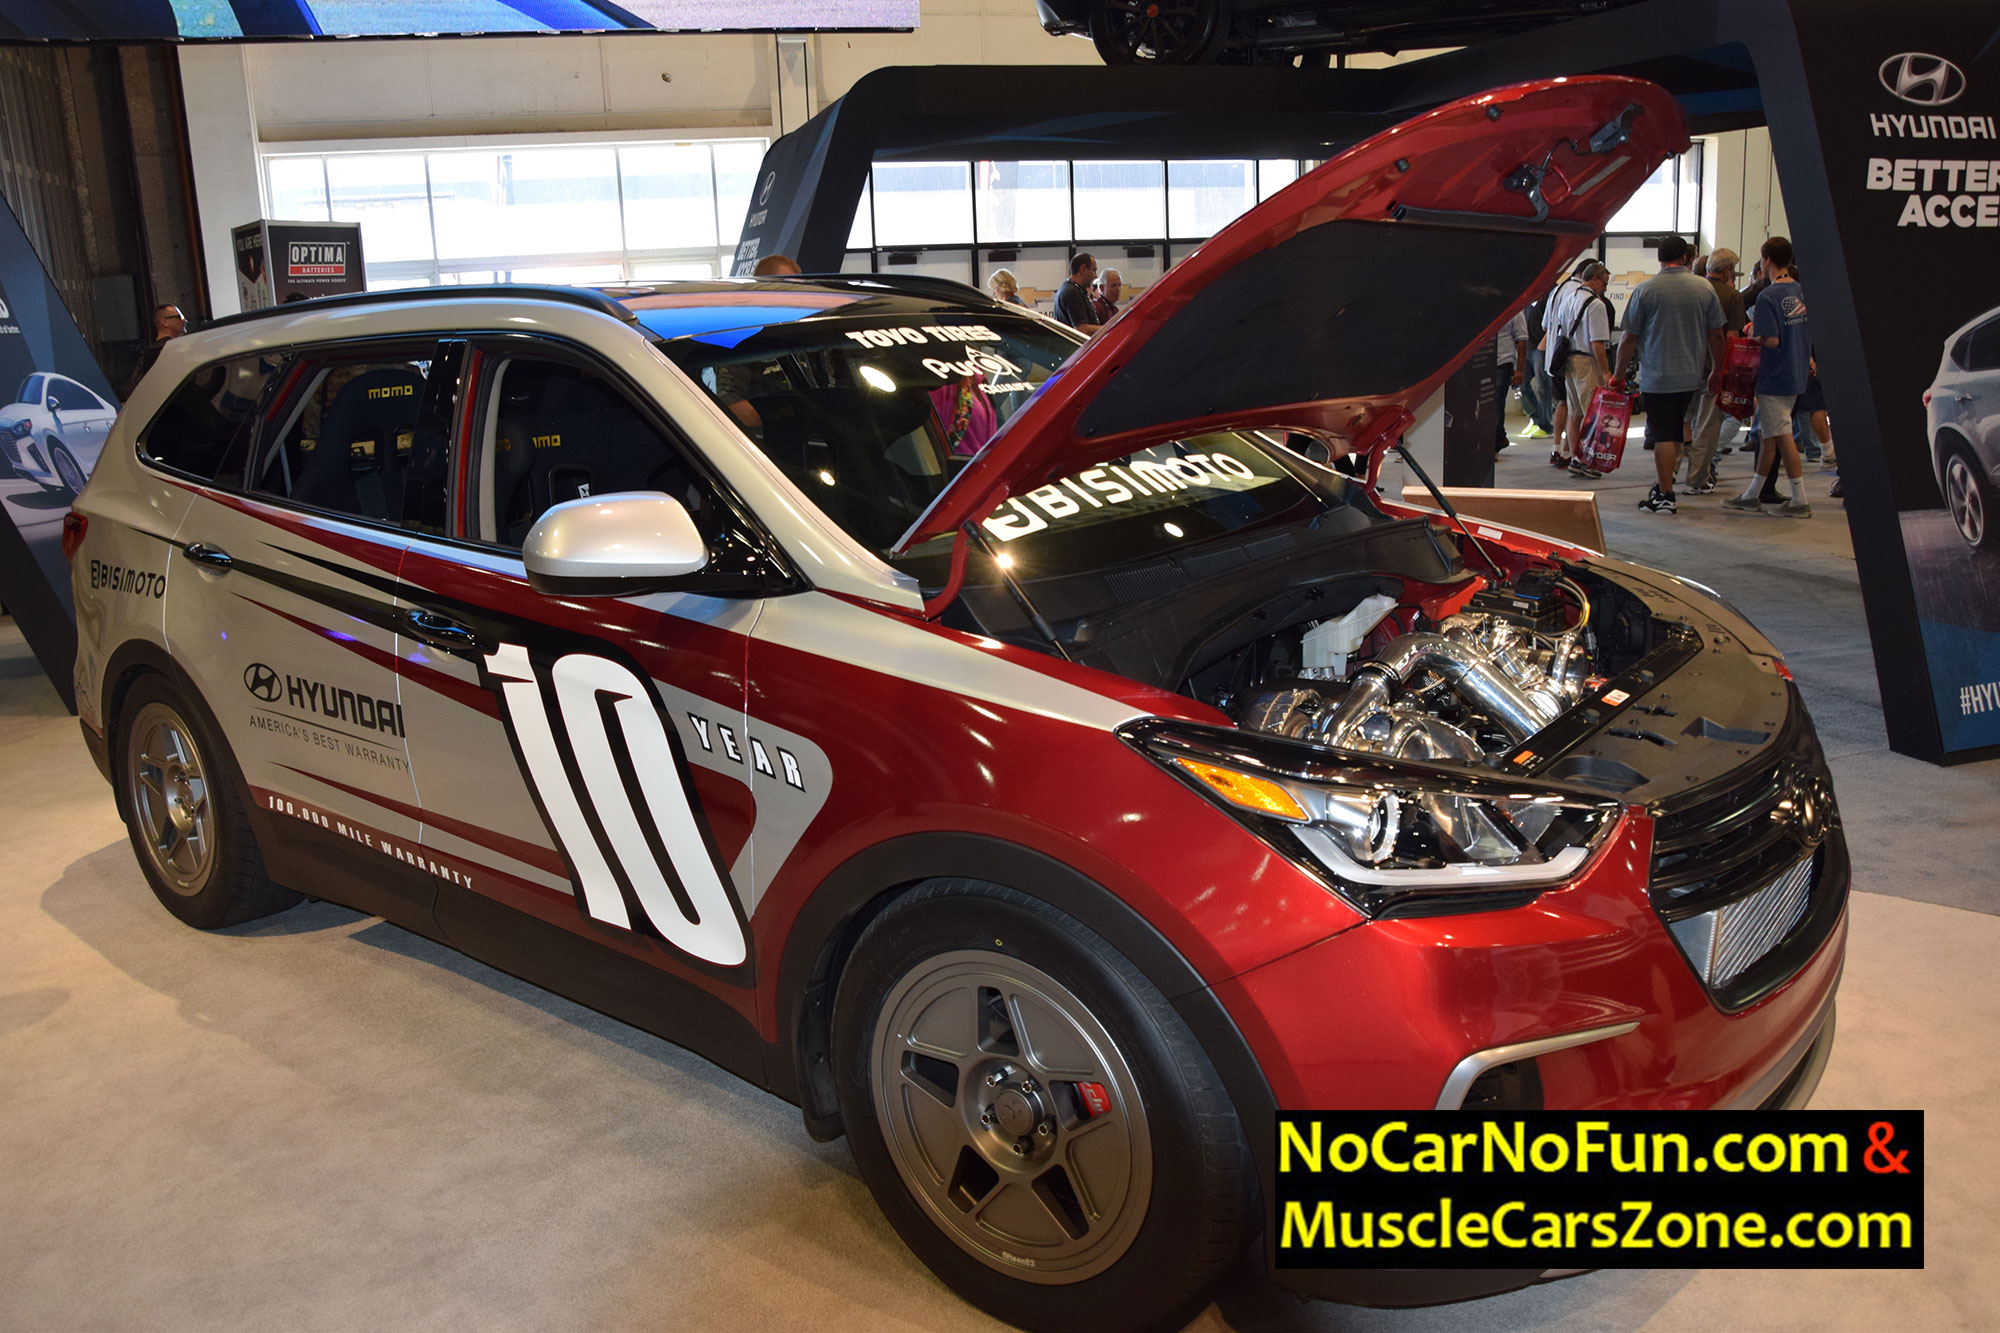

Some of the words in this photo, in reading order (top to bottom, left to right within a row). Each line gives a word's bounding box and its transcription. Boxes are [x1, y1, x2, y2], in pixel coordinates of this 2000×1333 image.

[1869, 112, 1997, 140] HYUNDAI
[291, 246, 343, 263] OPTIMA
[845, 326, 929, 349] TOYO
[920, 325, 1002, 342] TIRES
[101, 564, 166, 599] BISIMOTO
[285, 674, 406, 738] HYUNDAI
[250, 715, 309, 742] AMERICA'S
[313, 732, 341, 752] BEST
[344, 742, 410, 774] WARRANTY
[688, 713, 806, 792] YEAR
[483, 642, 747, 967] 10
[336, 822, 372, 847] MILE
[380, 840, 472, 889] WARRANTY
